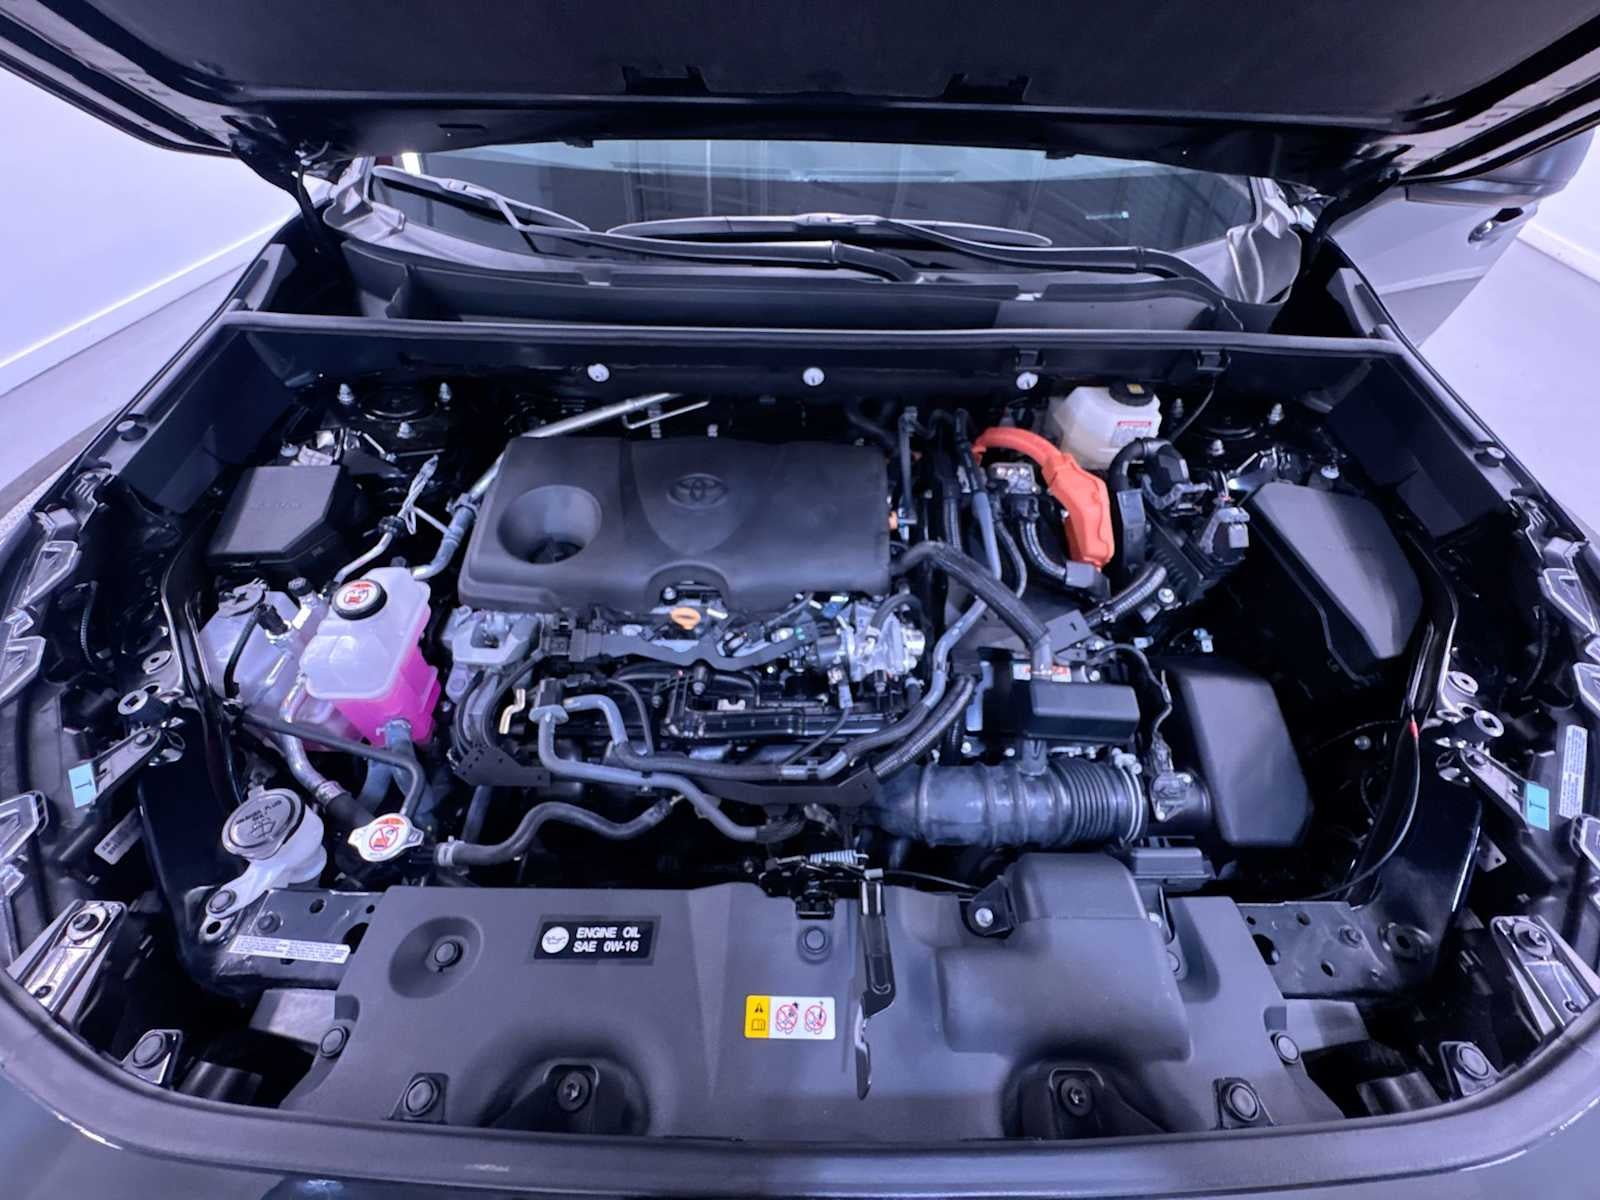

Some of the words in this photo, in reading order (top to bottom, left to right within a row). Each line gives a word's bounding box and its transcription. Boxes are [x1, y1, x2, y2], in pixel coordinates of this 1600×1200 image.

[576, 926, 618, 938] ENGINE
[622, 926, 641, 938] OIL
[573, 940, 598, 952] SAE
[603, 940, 639, 952] 0W-16
